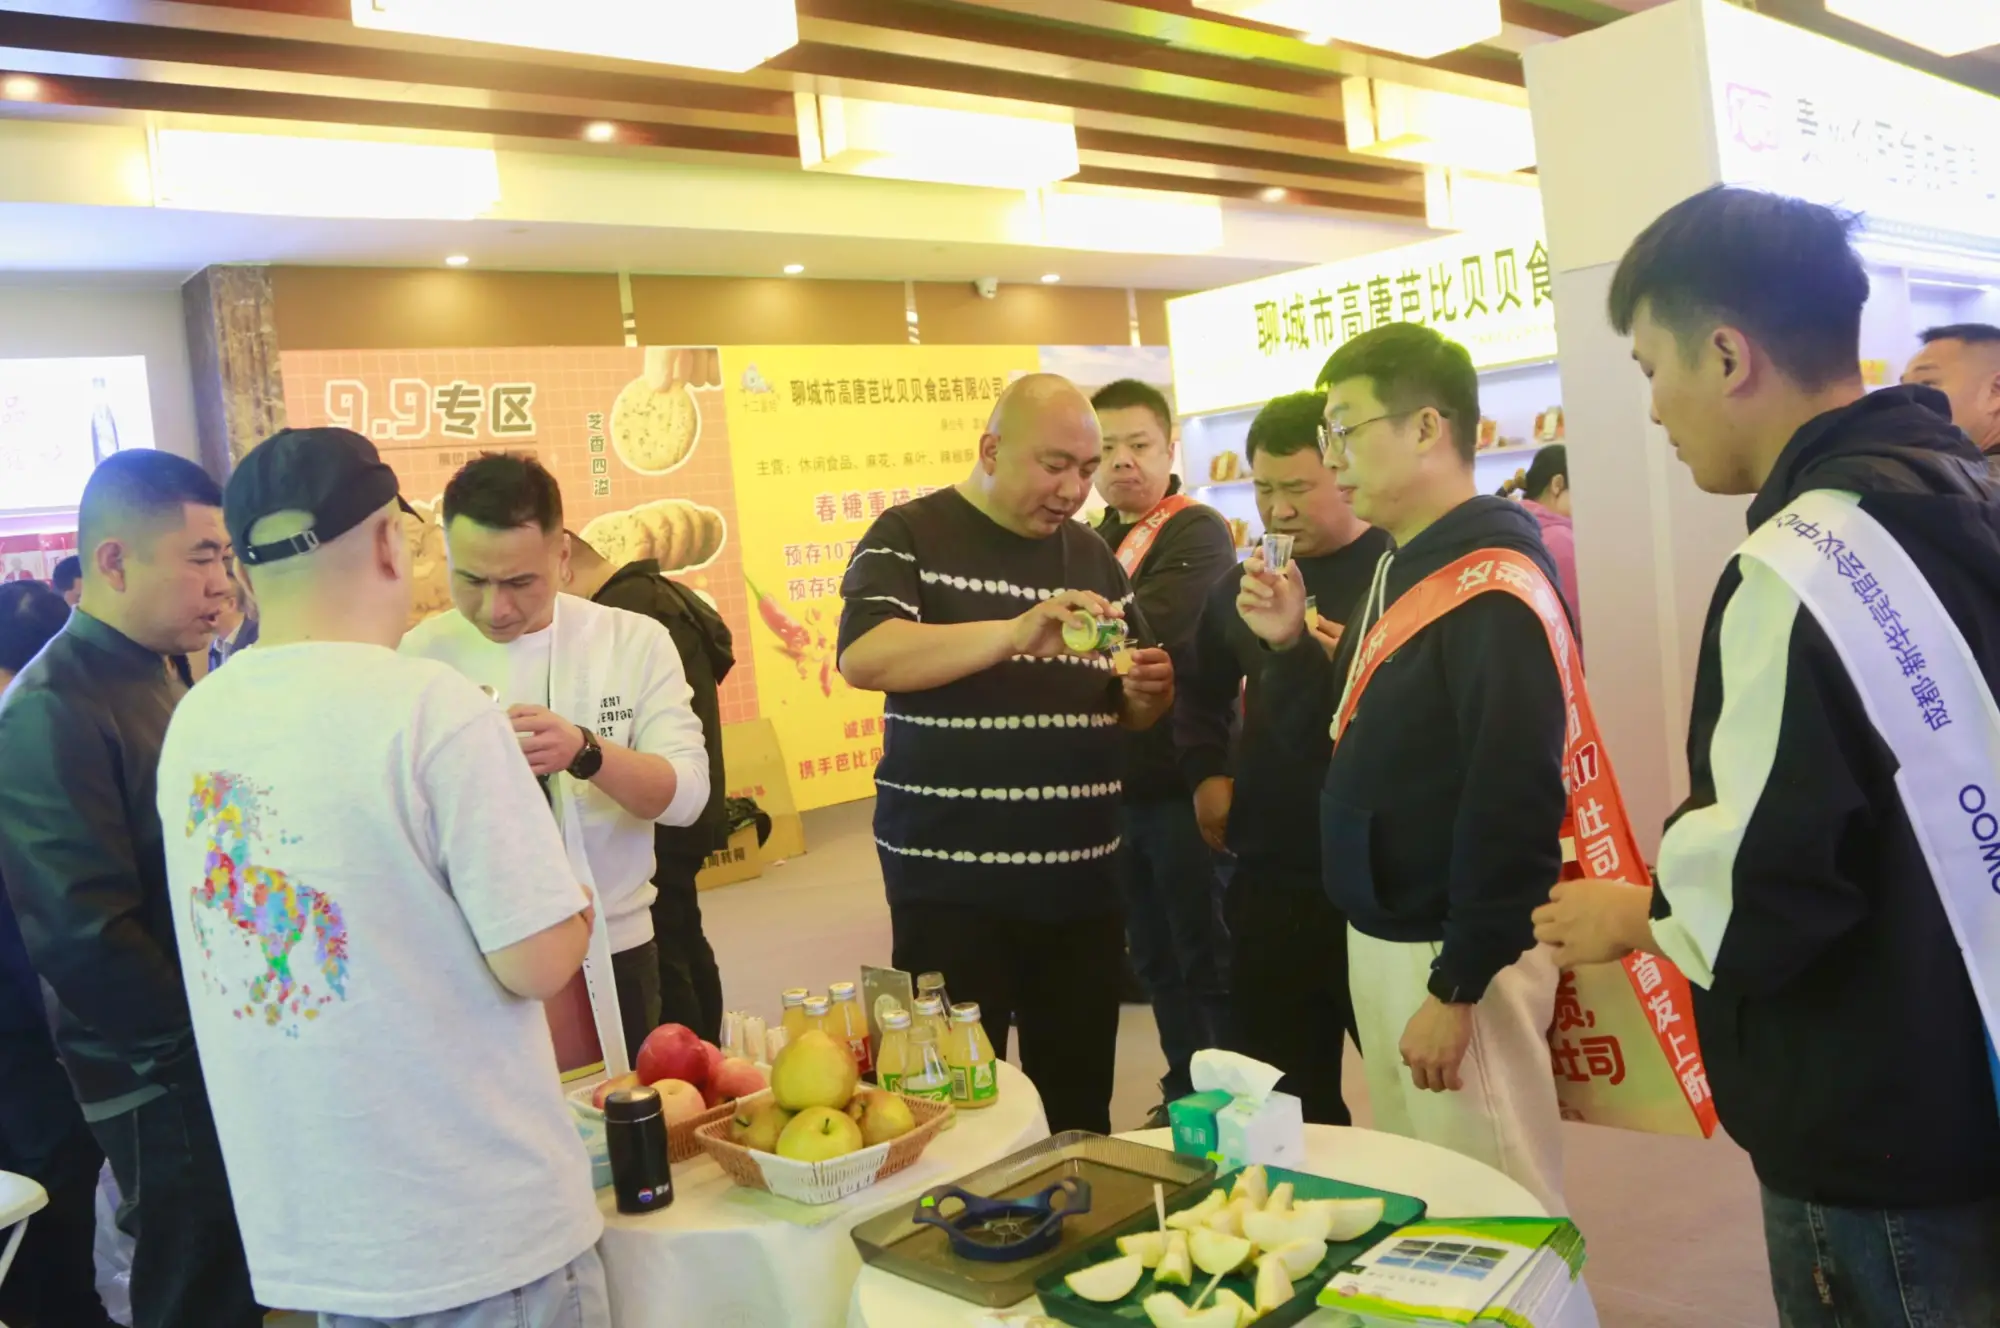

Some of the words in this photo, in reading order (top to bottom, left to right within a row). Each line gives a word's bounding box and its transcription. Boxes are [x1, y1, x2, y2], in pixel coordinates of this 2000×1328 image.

[790, 376, 1003, 406] 聊城市高唐芭比贝贝食品有限公司
[588, 413, 610, 496] 芝香四溢
[788, 576, 844, 601] 预存5
